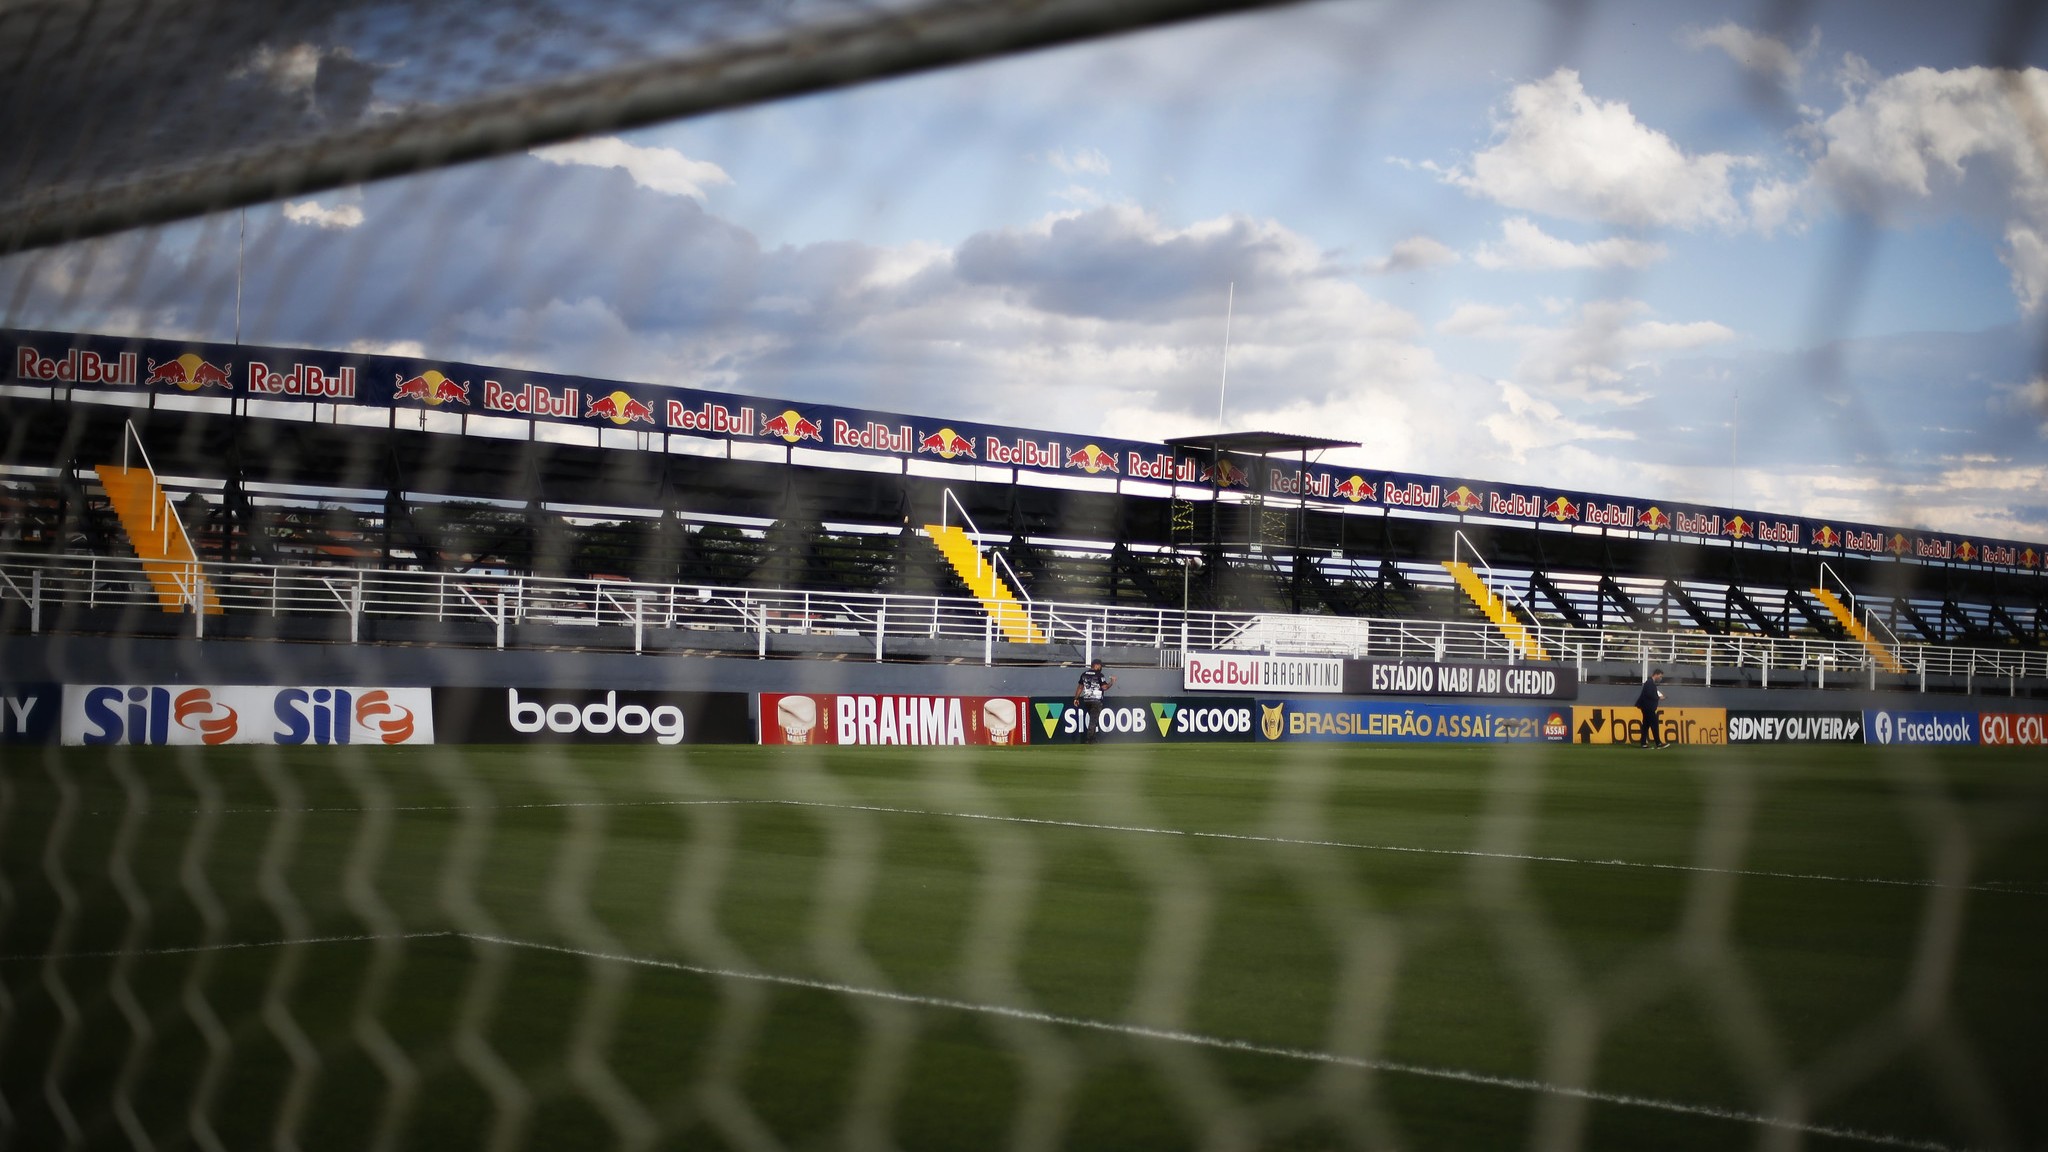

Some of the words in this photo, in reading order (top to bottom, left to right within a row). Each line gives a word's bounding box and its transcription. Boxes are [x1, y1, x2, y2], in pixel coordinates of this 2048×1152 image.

[1190, 660, 1224, 684] Red
[1227, 661, 1259, 685] Bull
[1264, 661, 1339, 686] BRAGANTINO
[1372, 661, 1432, 691] ESTÁDIO
[1438, 666, 1473, 693] NABI
[1477, 668, 1501, 694] ABI
[1505, 669, 1556, 695] CHEDID
[508, 688, 684, 744] bodog
[836, 696, 966, 745] BRAHMA
[1176, 708, 1251, 733] SICOOB
[1289, 710, 1432, 736] BRASILEIRÃO
[1436, 713, 1491, 738] ASSAÍ
[1494, 717, 1539, 737] 2021
[1611, 709, 1724, 744] befair.net
[1729, 717, 1786, 740] SIDNEY
[1786, 717, 1860, 740] OLIVEIRA
[1897, 717, 1971, 741] Facebook
[1982, 716, 2014, 744] GOL
